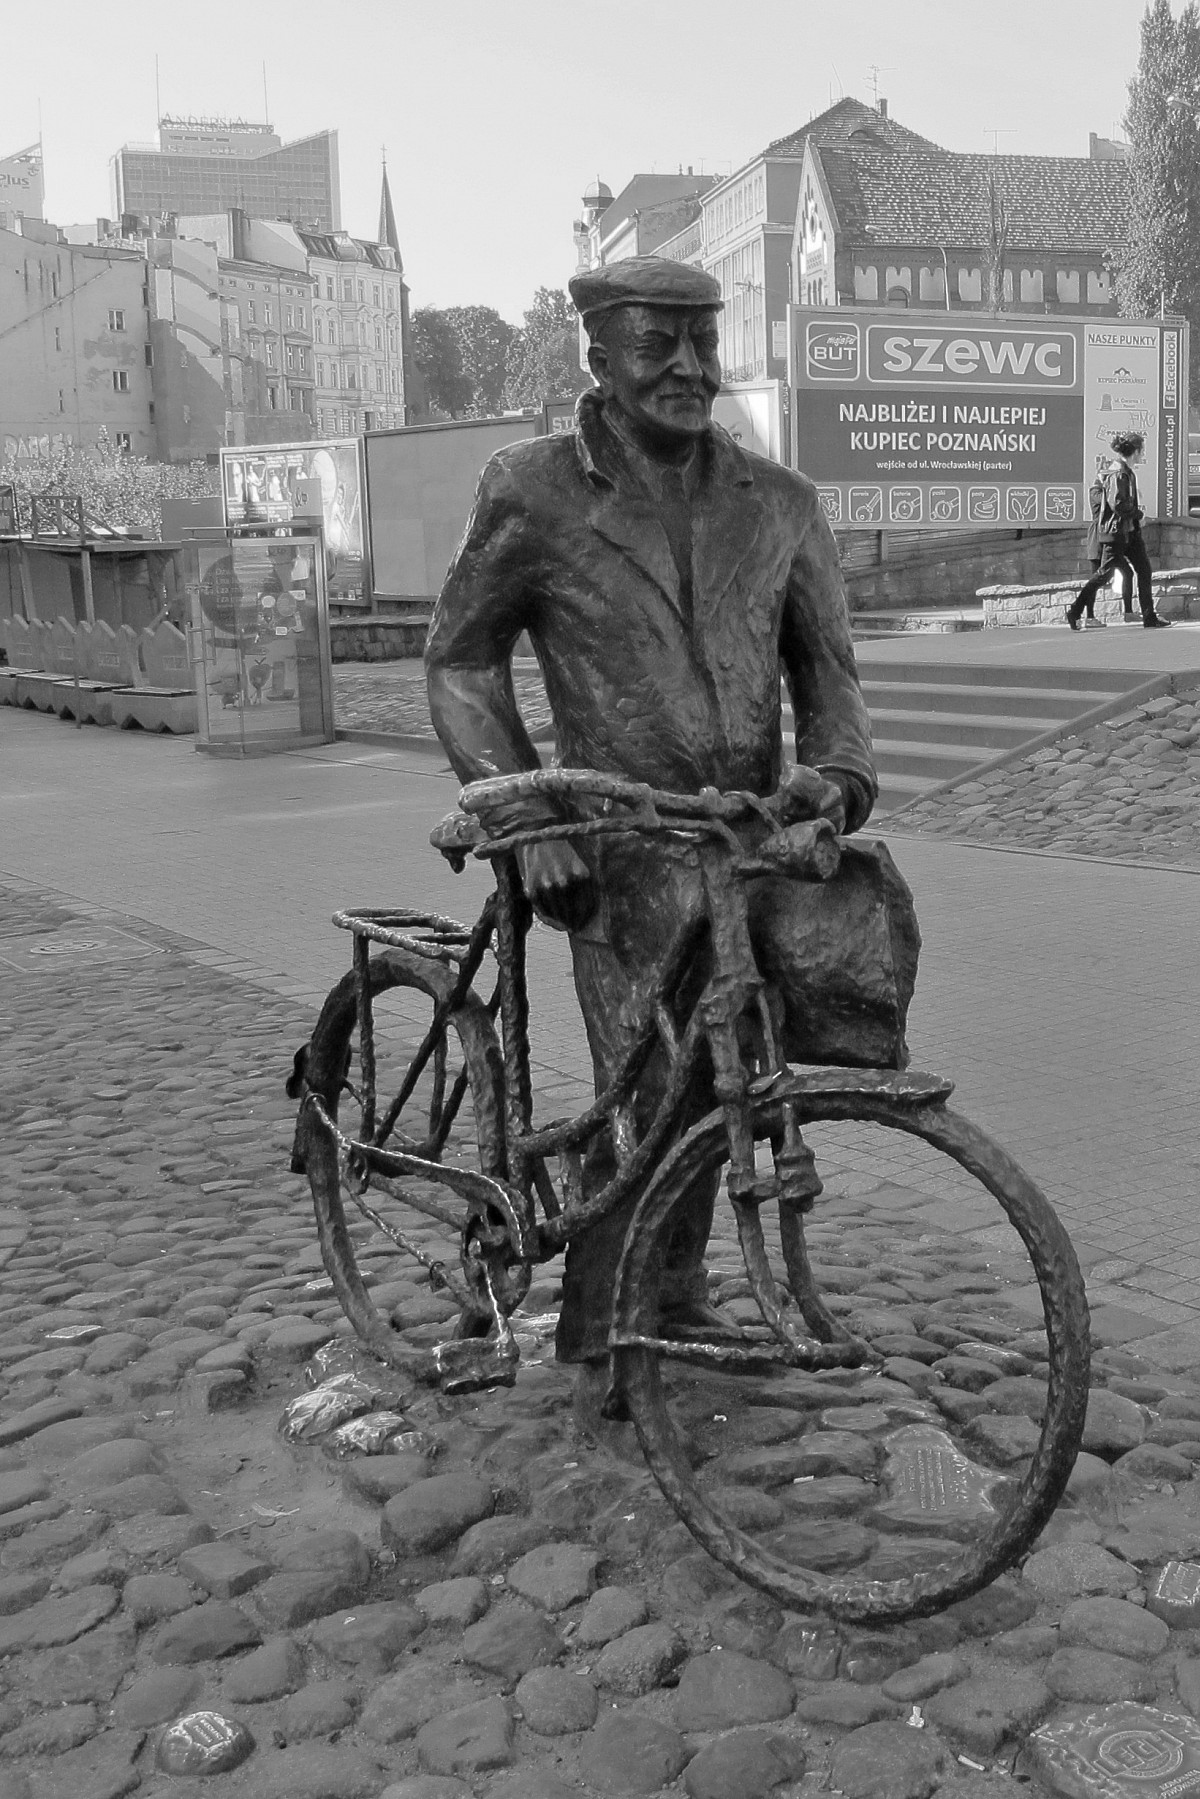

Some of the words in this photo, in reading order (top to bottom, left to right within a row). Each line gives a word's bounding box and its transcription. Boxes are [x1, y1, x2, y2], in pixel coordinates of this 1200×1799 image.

[1088, 333, 1118, 345] NASZE
[1120, 334, 1157, 346] PUNKTY
[814, 346, 857, 360] BUT
[883, 336, 1061, 377] szewc
[1165, 334, 1176, 392] Facebook
[839, 400, 936, 423] NAJBLIŻEJ
[942, 405, 948, 424] I
[954, 405, 1046, 425] NAJLEPIEJ
[850, 431, 921, 451] KUPIEC
[927, 428, 1036, 452] POZNAŃSKI
[876, 460, 906, 470] wejście
[907, 460, 918, 469] od
[919, 460, 930, 469] ul.
[983, 461, 1013, 471] (parter)
[1165, 414, 1176, 518] www.majsterbut.pl
[1160, 1770, 1200, 1791] KOMPANIA
